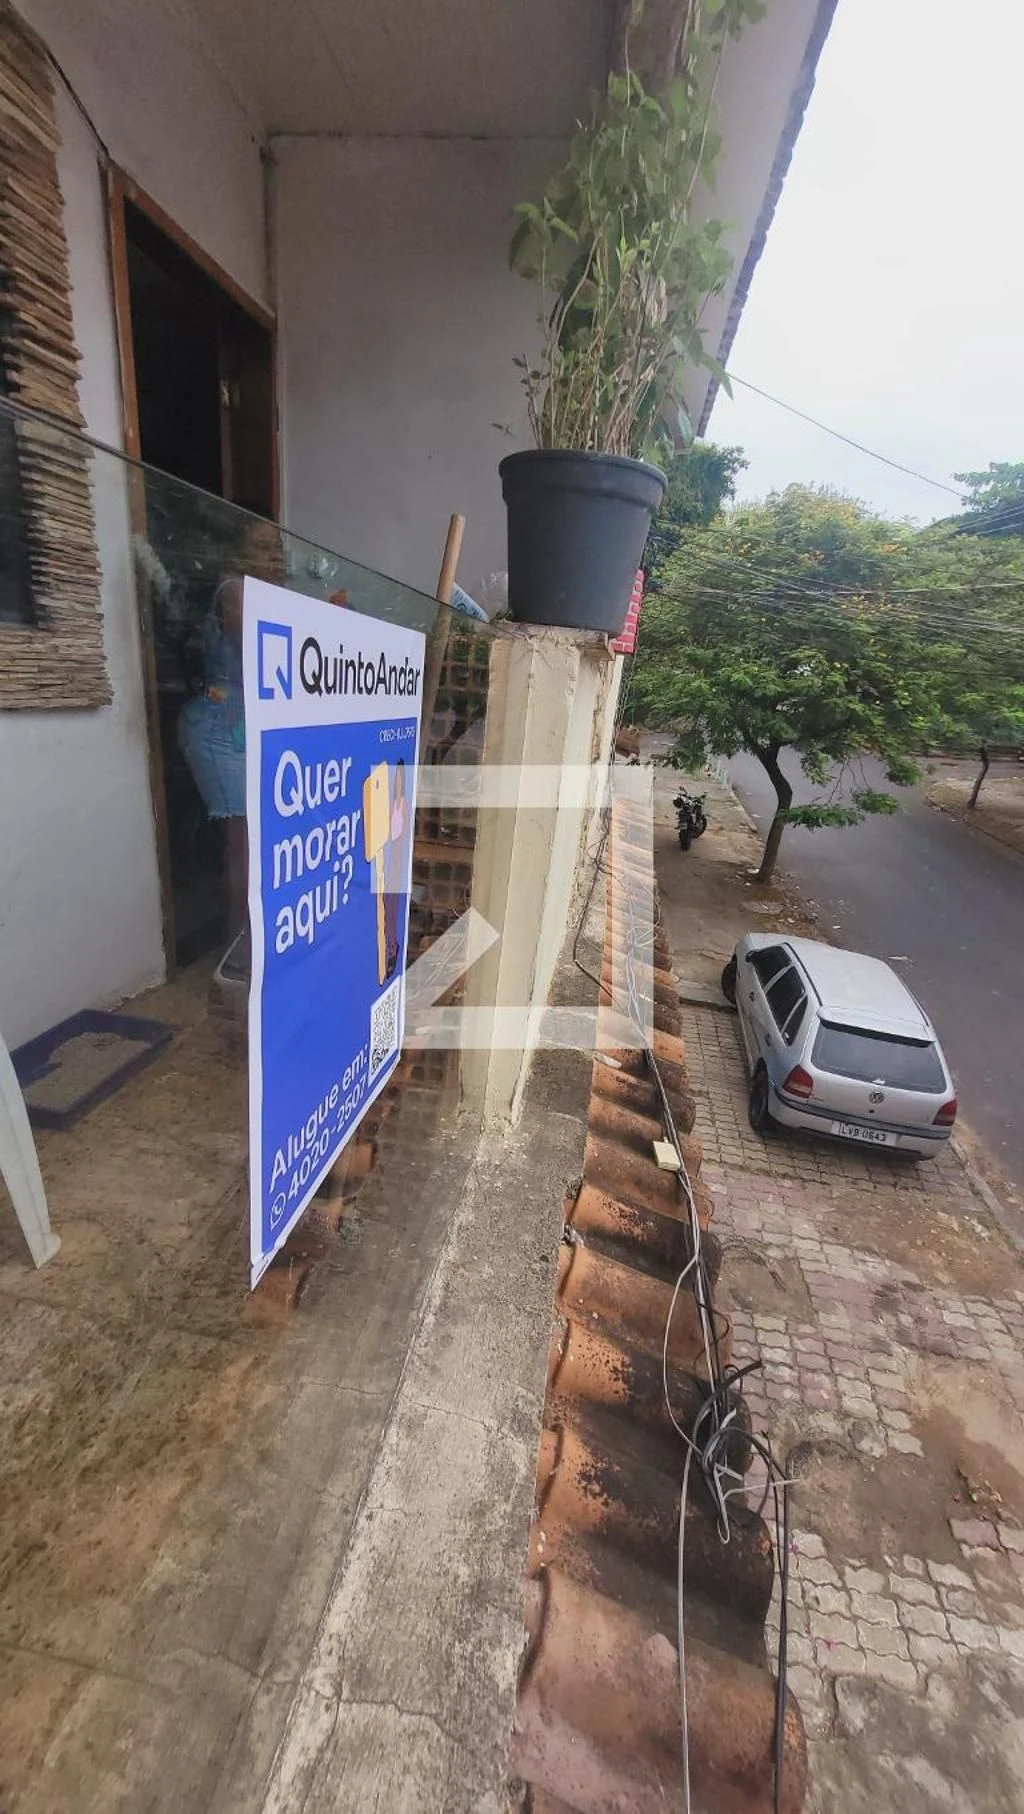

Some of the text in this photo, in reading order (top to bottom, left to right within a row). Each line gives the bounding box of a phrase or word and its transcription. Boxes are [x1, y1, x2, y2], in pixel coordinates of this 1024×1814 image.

[300, 636, 420, 697] QuintoAndar
[274, 750, 352, 818] Quer
[273, 810, 361, 890] morar
[275, 854, 353, 954] aqui?
[269, 1043, 369, 1194] Alugue em:
